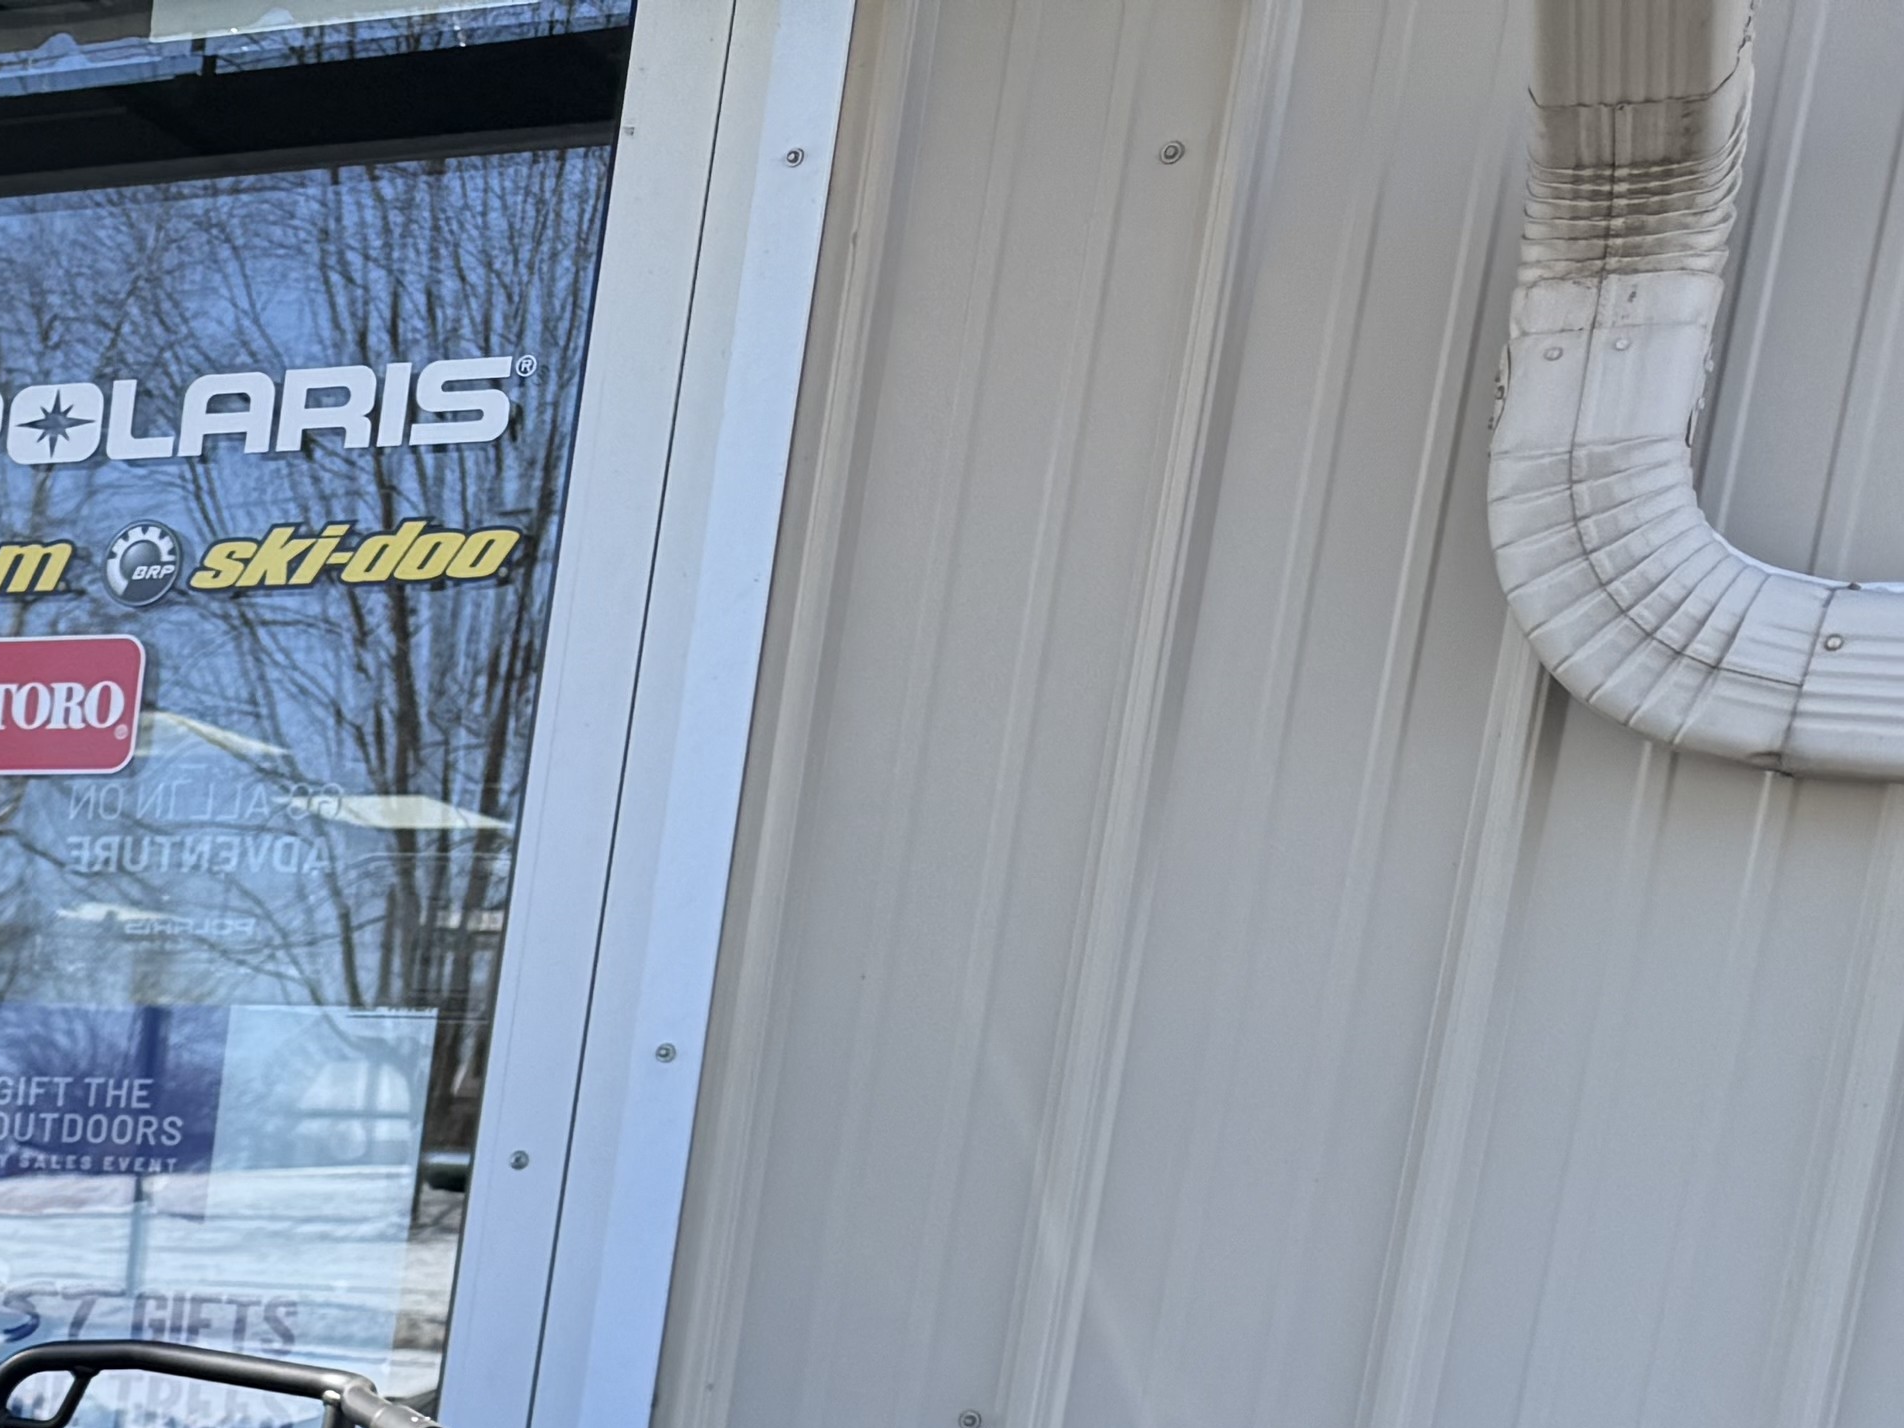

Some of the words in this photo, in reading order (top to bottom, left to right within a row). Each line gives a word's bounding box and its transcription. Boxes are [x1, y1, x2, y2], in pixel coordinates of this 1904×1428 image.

[131, 560, 176, 581] BRP
[189, 520, 521, 590] ski-doo
[84, 1077, 154, 1109] THE
[19, 1151, 93, 1171] SALES
[103, 1156, 179, 1173] EVENT
[132, 1289, 299, 1354] GIFTS
